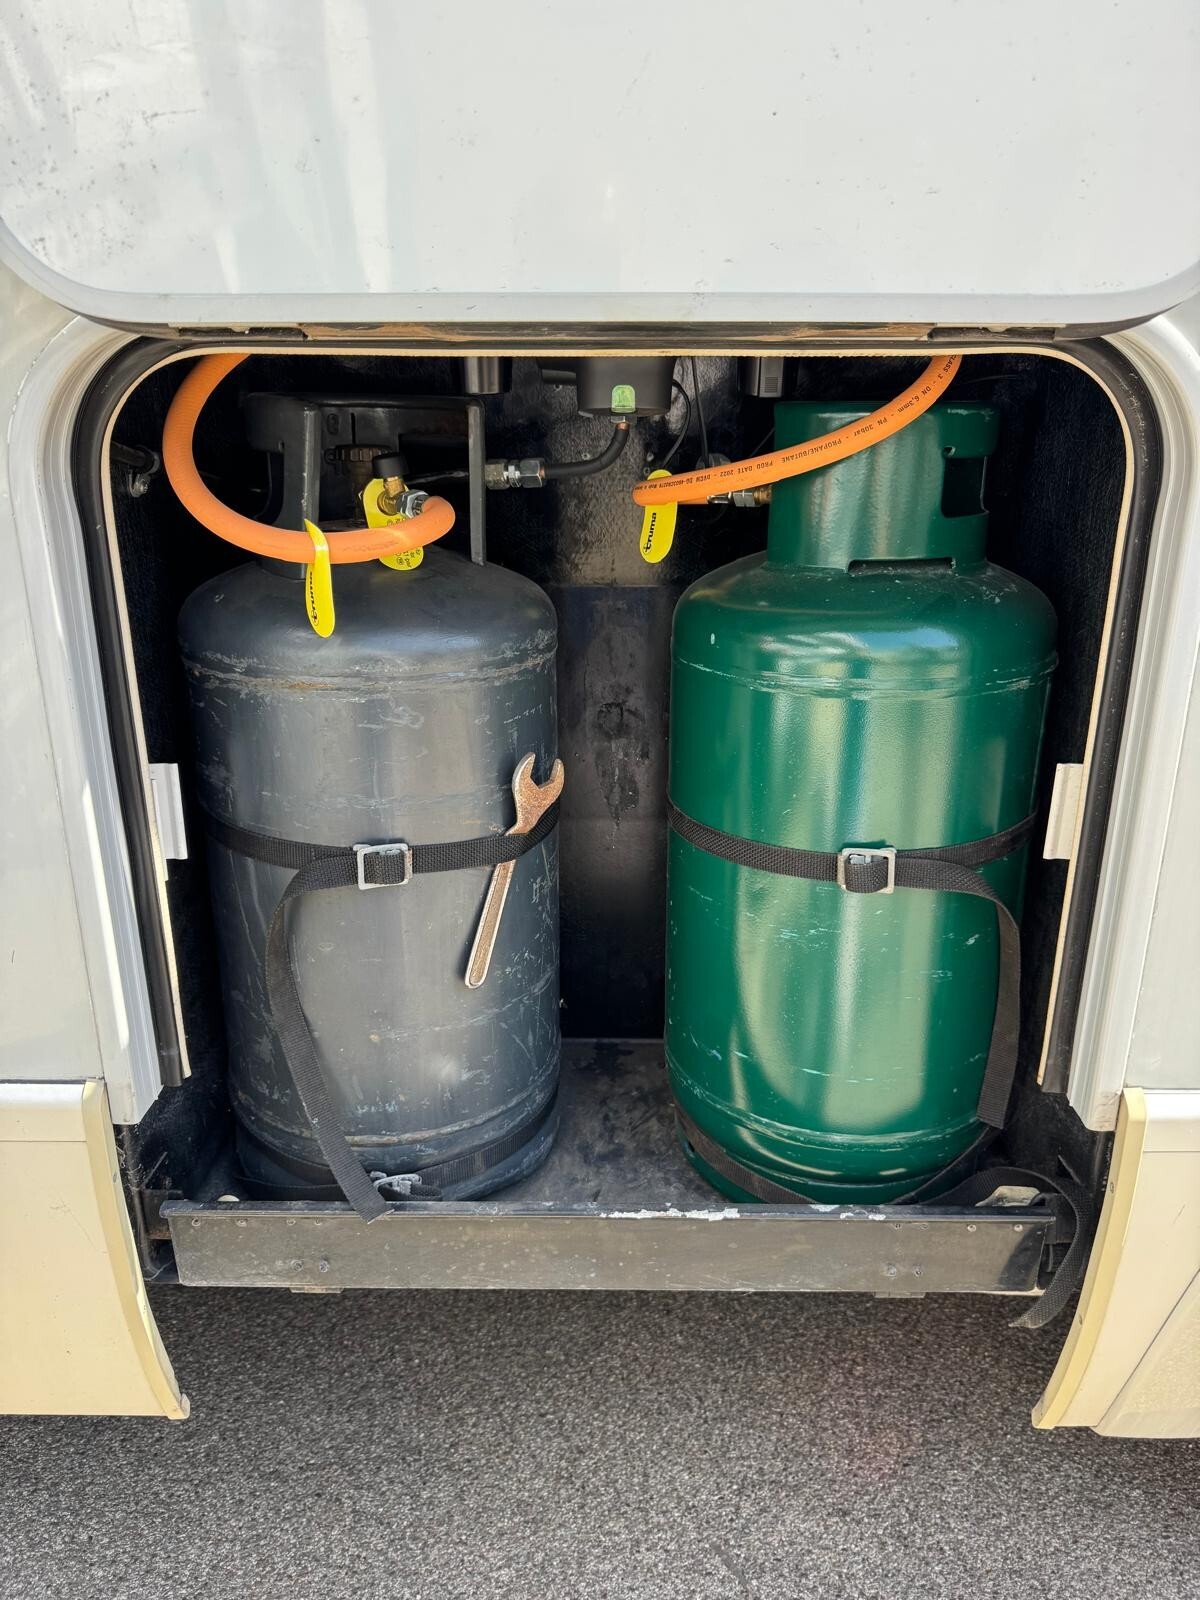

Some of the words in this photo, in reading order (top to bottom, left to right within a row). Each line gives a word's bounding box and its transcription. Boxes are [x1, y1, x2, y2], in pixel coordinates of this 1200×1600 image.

[921, 386, 932, 396] DN
[898, 395, 920, 413] 6,3mm
[877, 417, 888, 426] PN
[854, 424, 874, 437] 30bar
[782, 438, 842, 464] PROPANE/BUTANE
[738, 465, 752, 474] DATE
[756, 460, 773, 470] PROD
[720, 469, 734, 478] 2022
[643, 512, 656, 552] truma
